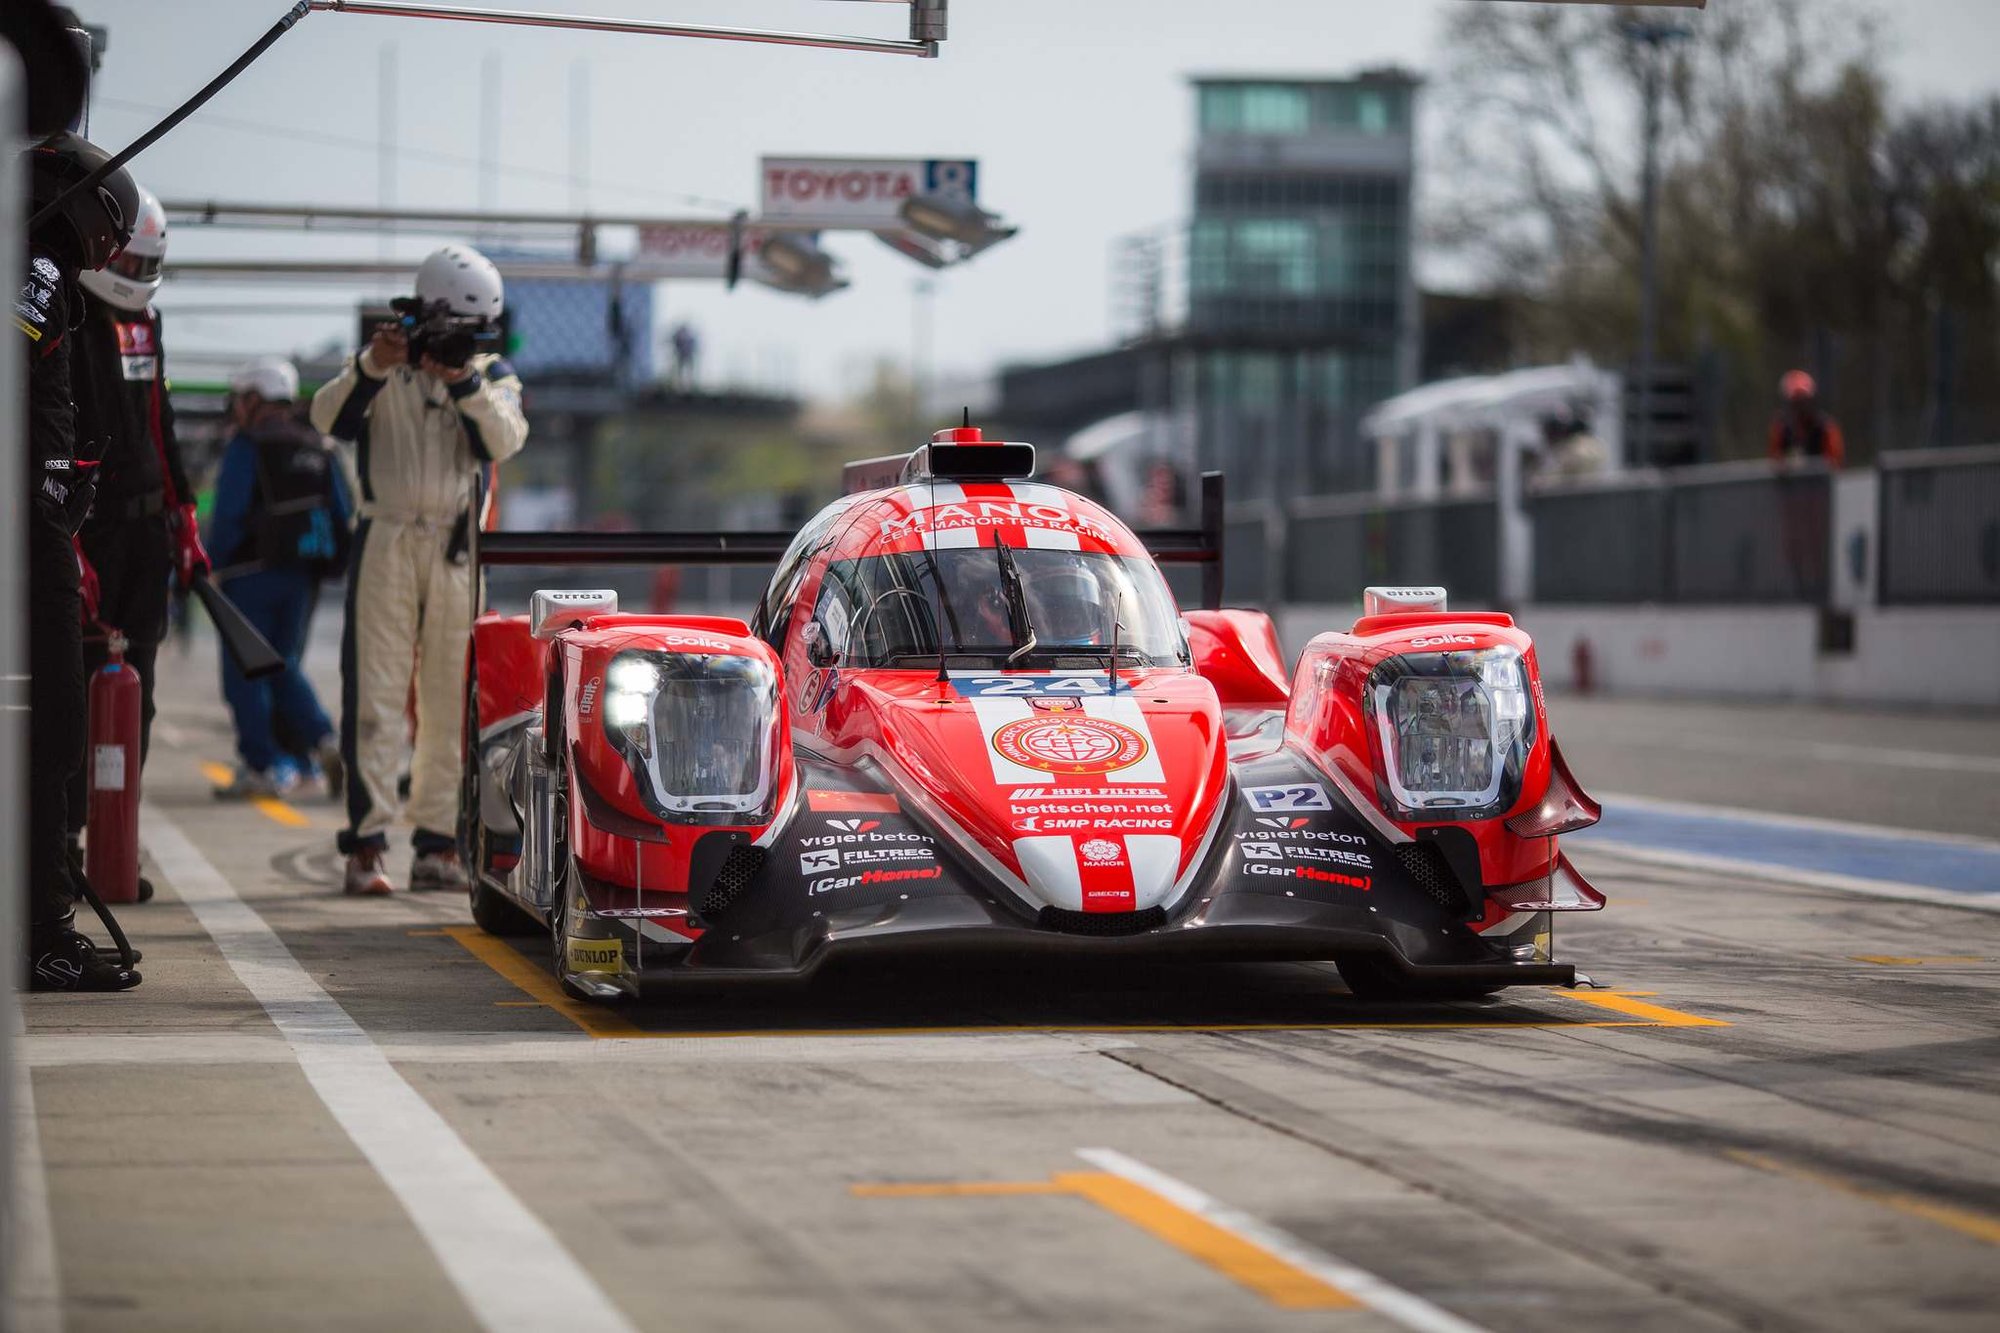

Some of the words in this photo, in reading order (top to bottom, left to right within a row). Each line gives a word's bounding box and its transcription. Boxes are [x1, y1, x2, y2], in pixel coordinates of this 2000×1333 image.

[765, 169, 919, 199] TOYOTA
[879, 502, 1111, 536] MANOR
[880, 522, 925, 545] CEFC
[930, 517, 1005, 531] MANOR
[1009, 517, 1046, 528] TRS
[1049, 521, 1119, 547] RACING
[971, 678, 1111, 695] 24
[1018, 717, 1069, 730] ENERGY
[1030, 737, 1107, 750] CEFC
[1051, 788, 1092, 796] HIFI
[1100, 788, 1162, 797] FILTER
[1252, 788, 1323, 808] P2
[1010, 803, 1173, 815] bettschen.net
[1042, 819, 1089, 828] SMP
[1093, 818, 1173, 829] RACING
[800, 832, 867, 847] vigier
[870, 831, 935, 844] beton
[1234, 831, 1299, 840] vigier
[1302, 830, 1367, 846] beton
[843, 848, 933, 860] FILTREC
[1284, 846, 1372, 864] FILTREC
[573, 949, 618, 964] DUNLOP
